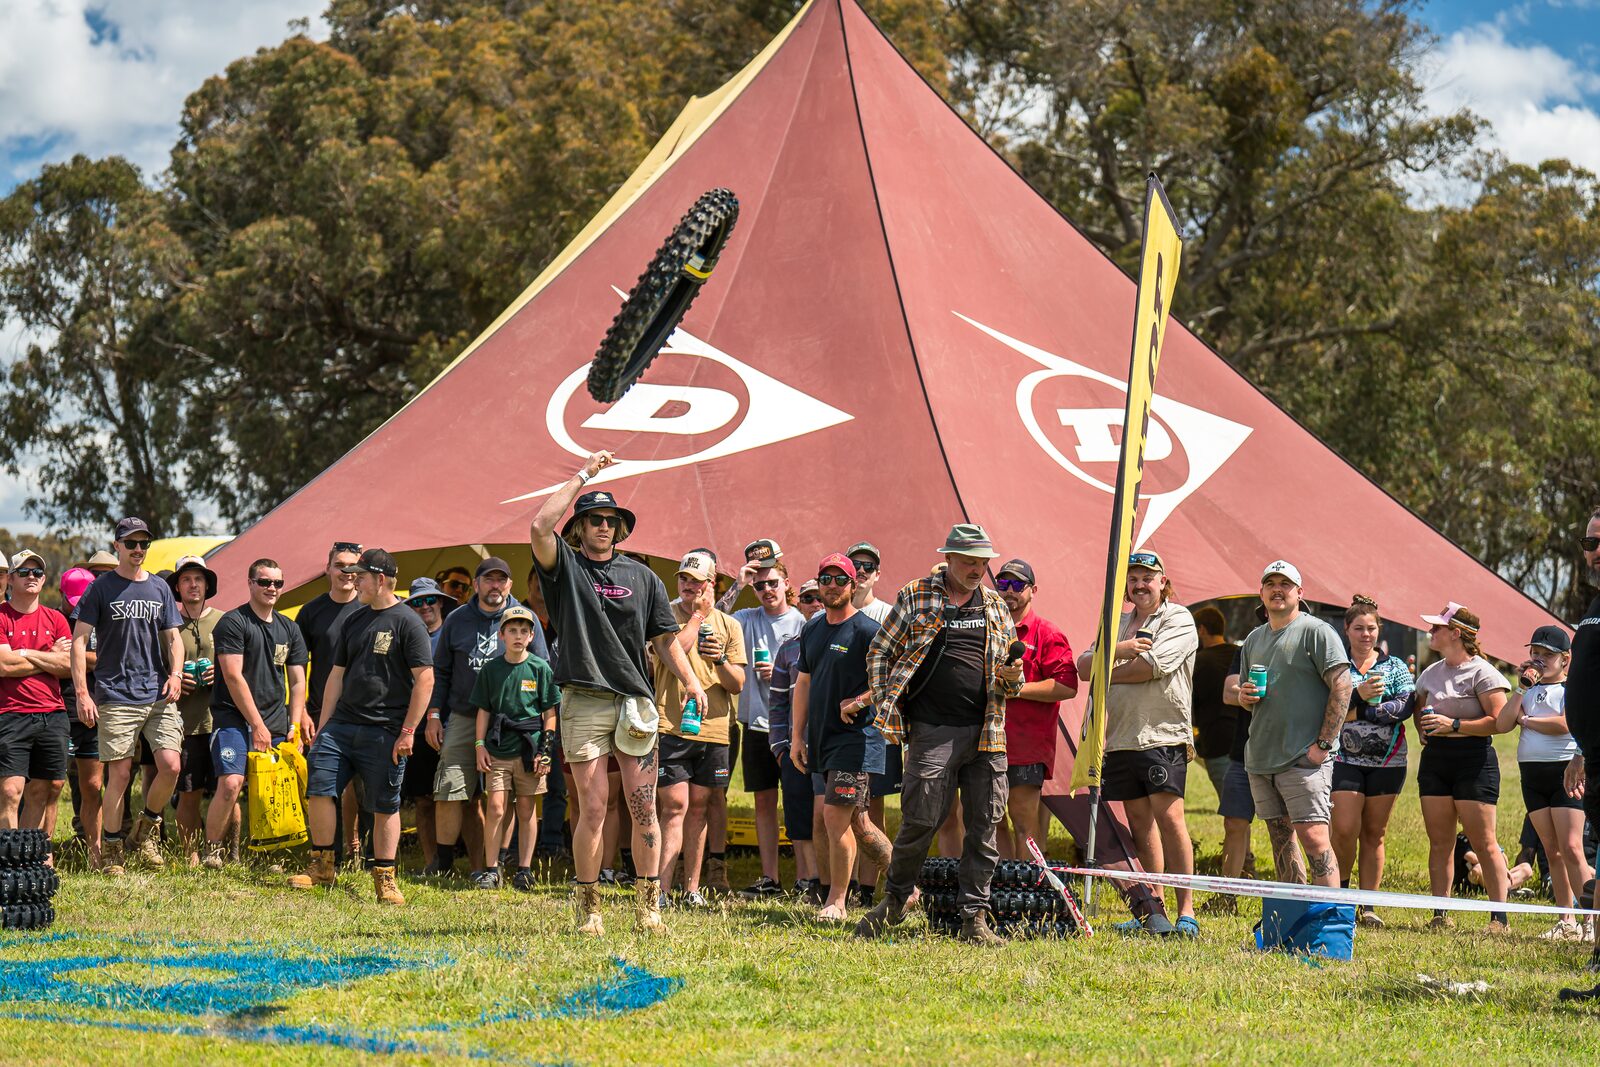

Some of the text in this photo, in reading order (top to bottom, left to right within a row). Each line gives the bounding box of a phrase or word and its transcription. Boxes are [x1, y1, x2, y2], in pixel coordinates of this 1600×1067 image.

[581, 383, 740, 435] D
[1056, 408, 1173, 463] D
[110, 599, 163, 624] SAINT
